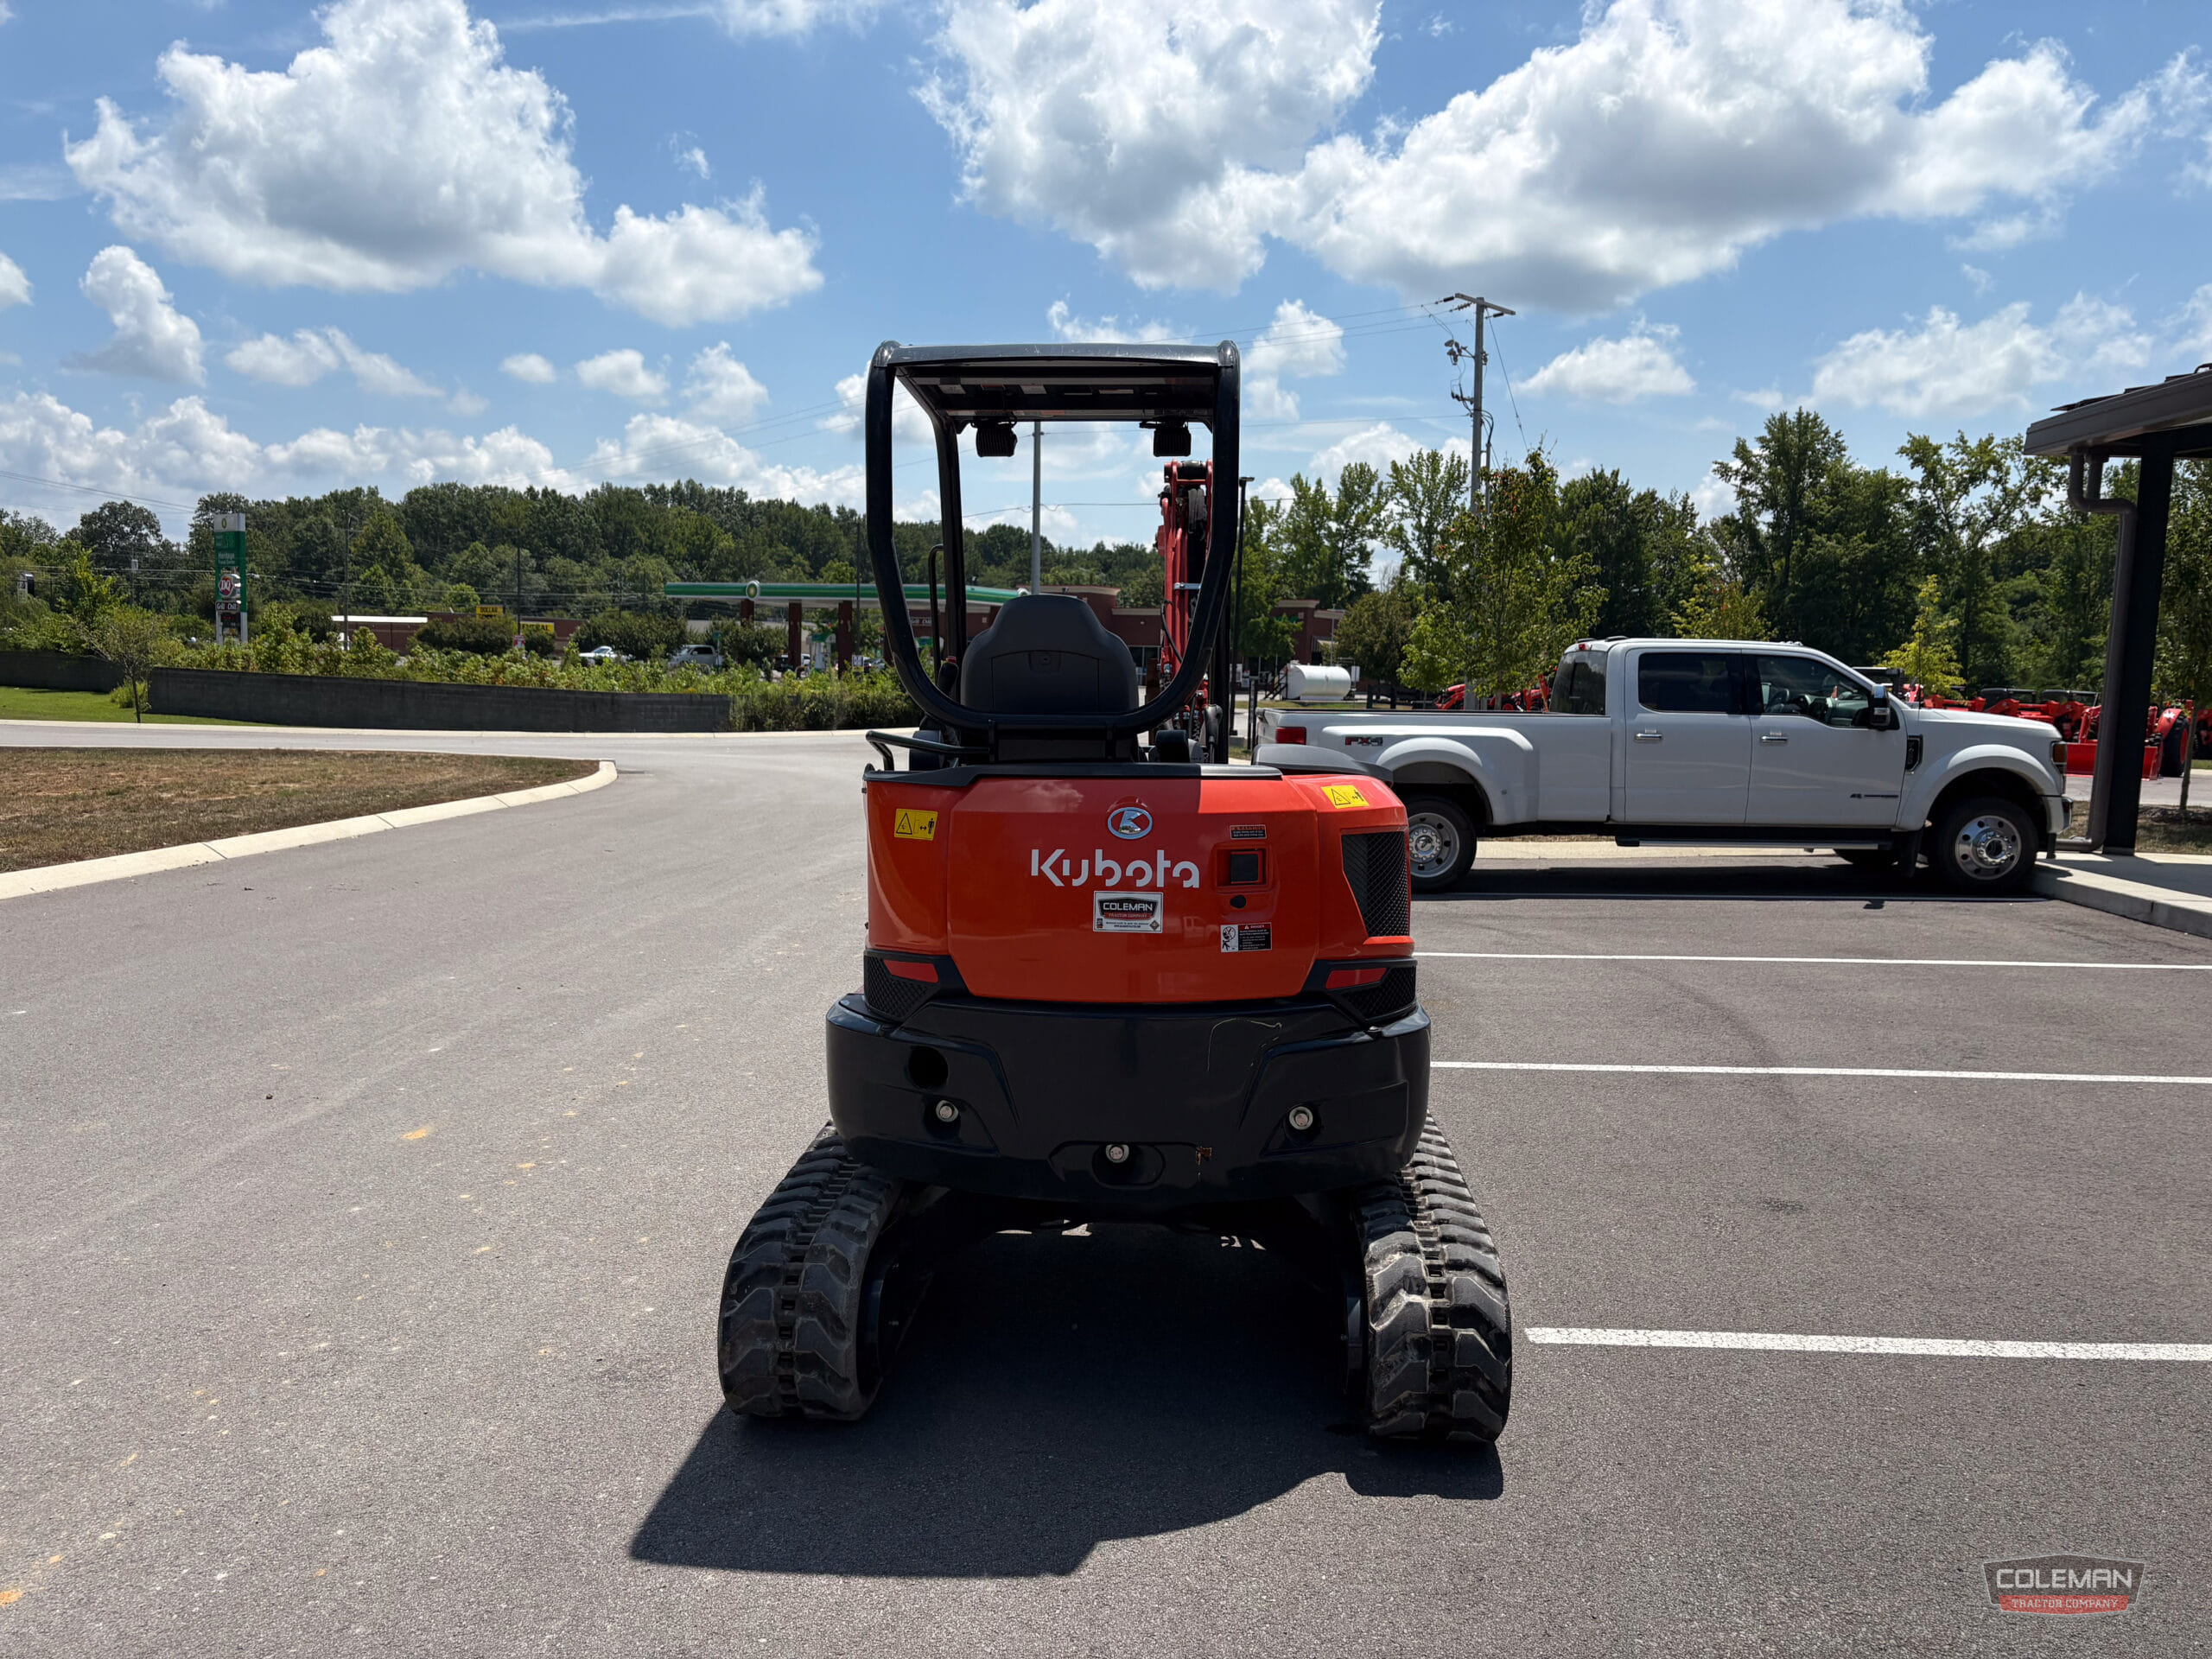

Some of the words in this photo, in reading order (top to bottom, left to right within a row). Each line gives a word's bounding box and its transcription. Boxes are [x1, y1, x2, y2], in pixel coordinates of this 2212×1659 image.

[221, 580, 231, 592] DQ
[1344, 736, 1383, 747] FX4
[1031, 849, 1200, 888] Kubota
[1103, 902, 1154, 912] COLEMAN
